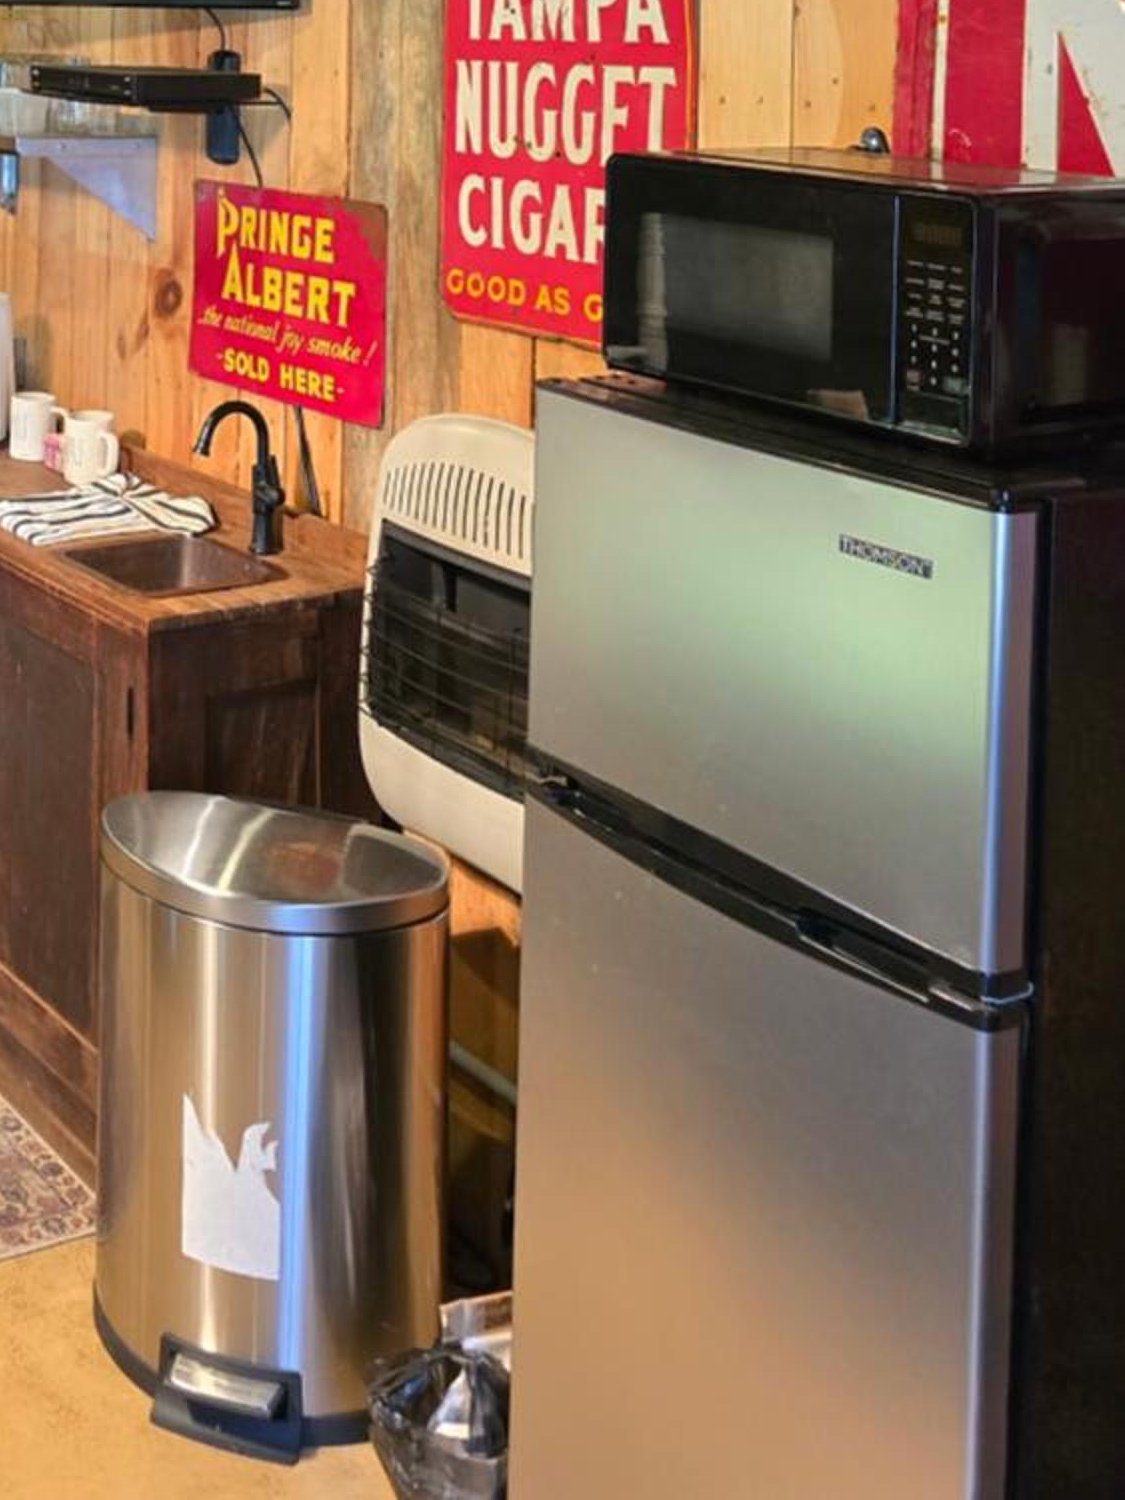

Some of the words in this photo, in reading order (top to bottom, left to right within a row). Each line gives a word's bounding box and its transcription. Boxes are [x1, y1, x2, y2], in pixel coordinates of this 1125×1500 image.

[221, 239, 356, 328] ALBERT
[446, 268, 527, 307] GOOD
[535, 285, 570, 316] AS
[224, 314, 281, 344] national
[275, 323, 305, 356] joy
[223, 348, 270, 382] SOLD
[280, 363, 335, 402] HERE
[839, 532, 934, 580] THOMSON
